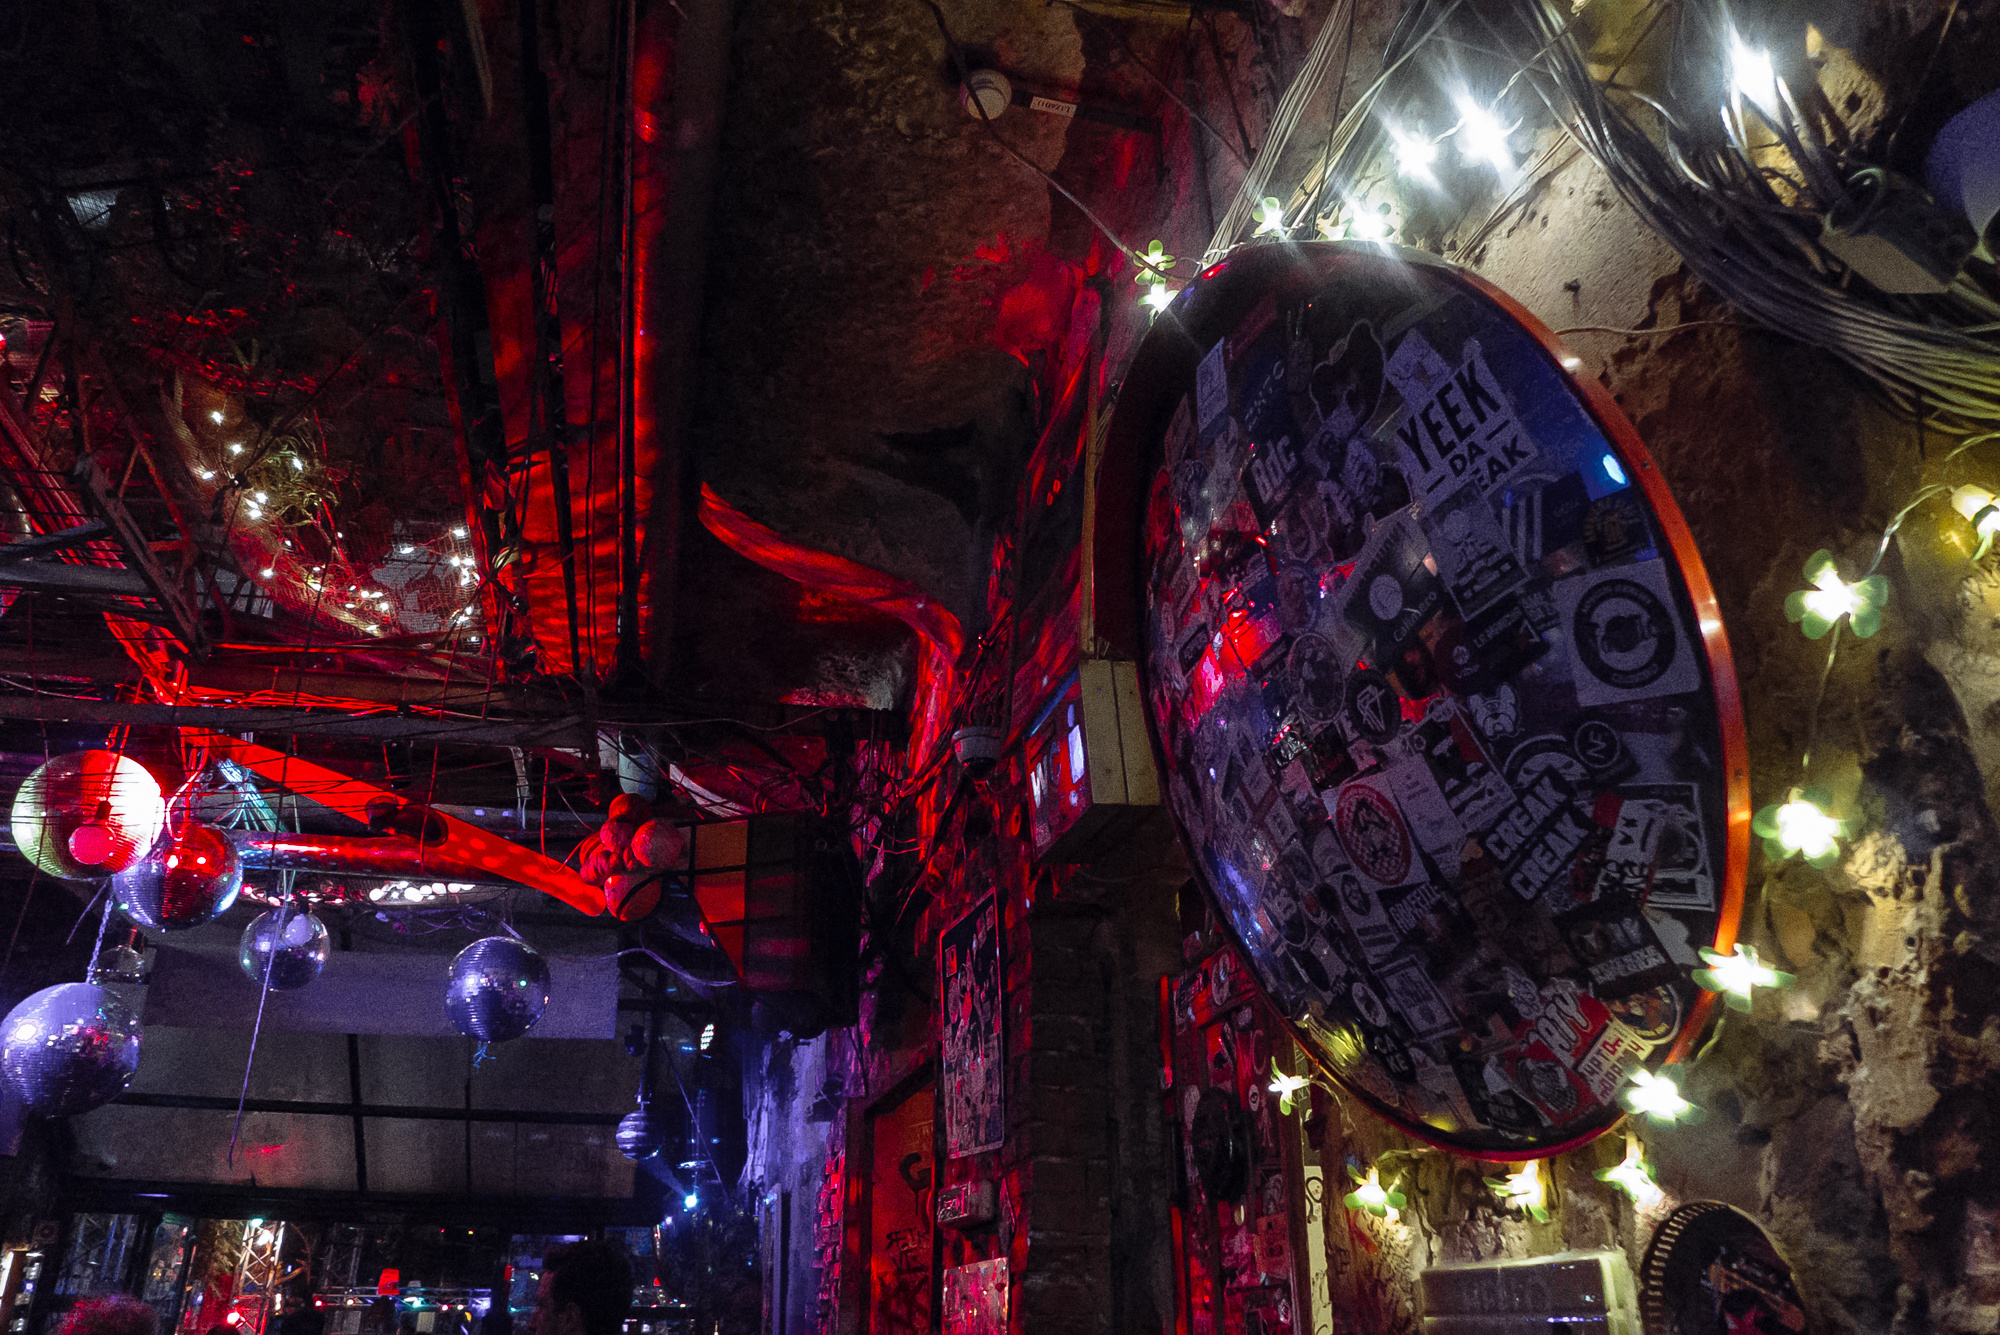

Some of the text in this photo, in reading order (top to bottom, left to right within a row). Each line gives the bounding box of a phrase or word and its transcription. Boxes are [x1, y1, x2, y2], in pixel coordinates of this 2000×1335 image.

[1397, 360, 1501, 473] YEEK
[1450, 442, 1486, 477] DA
[1471, 435, 1531, 491] EAK
[1392, 590, 1438, 643] Calimero
[1485, 775, 1568, 862] CREAK
[1510, 812, 1590, 901] CREAK
